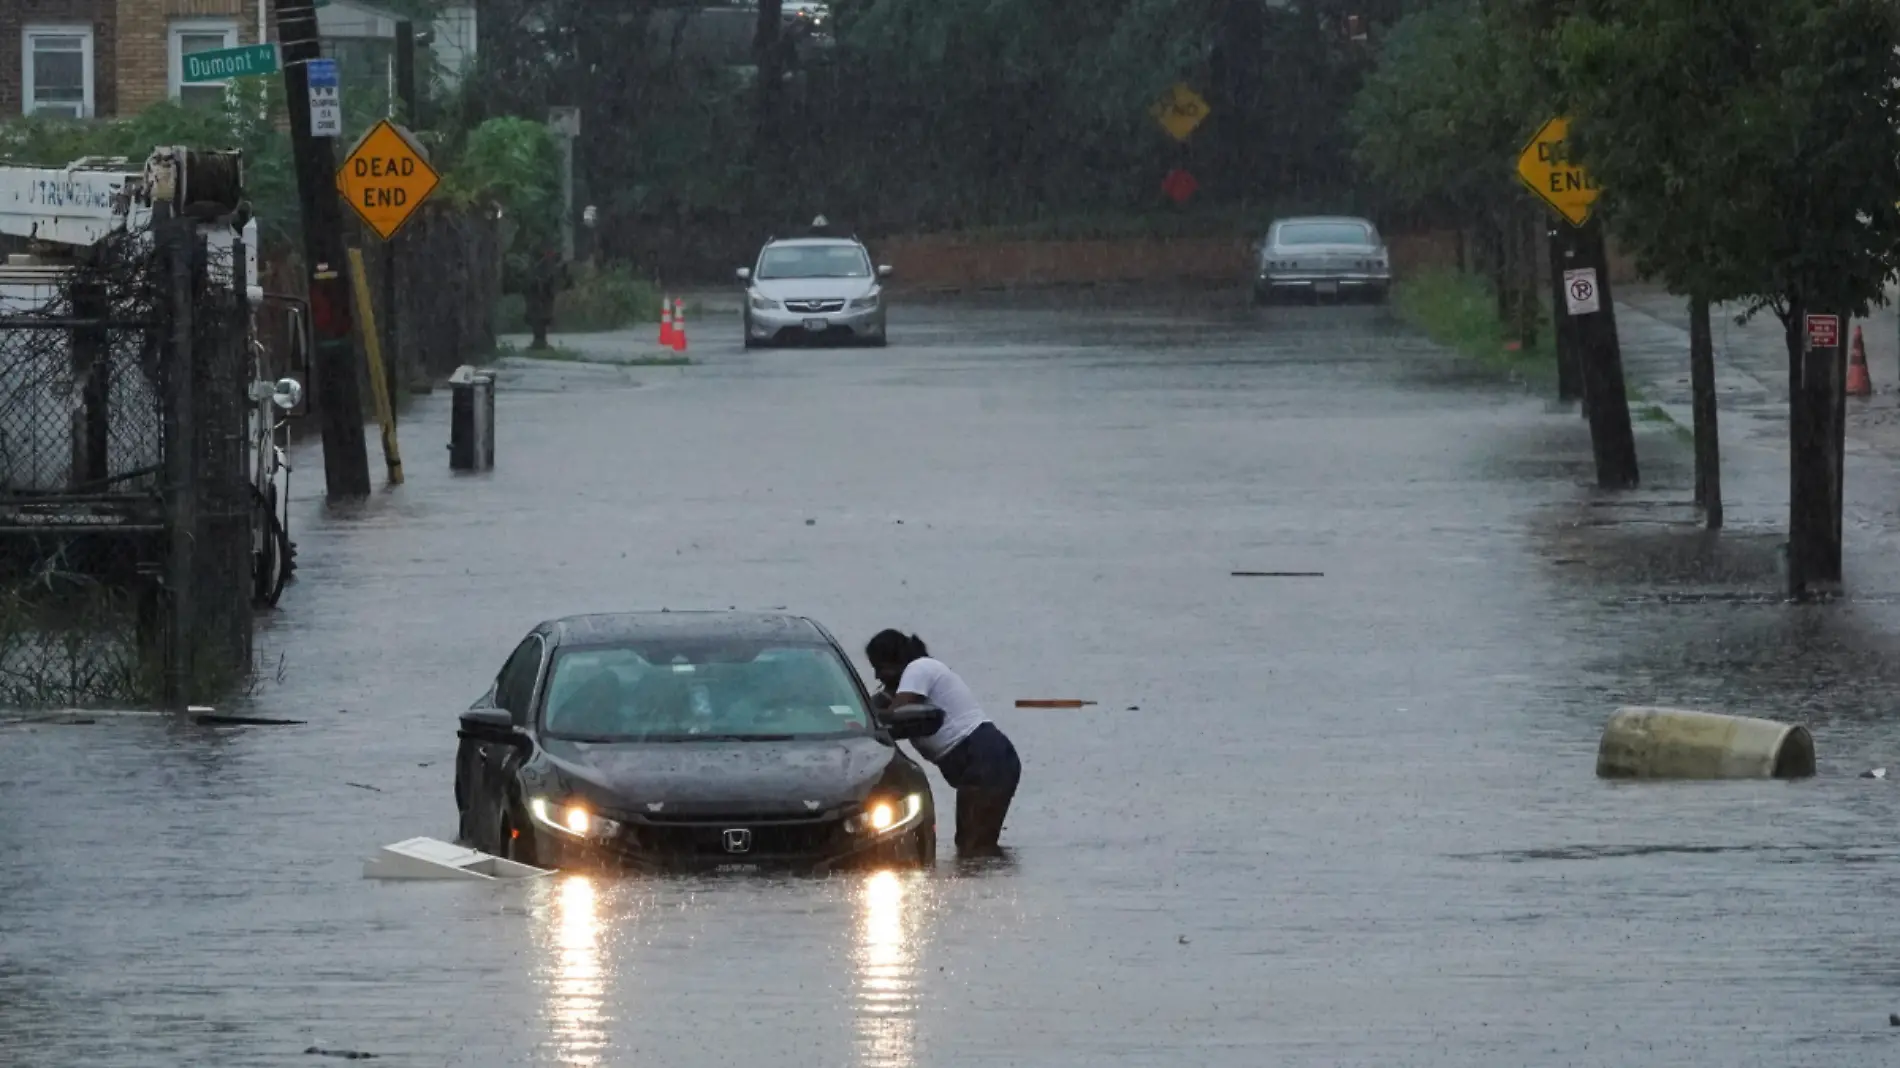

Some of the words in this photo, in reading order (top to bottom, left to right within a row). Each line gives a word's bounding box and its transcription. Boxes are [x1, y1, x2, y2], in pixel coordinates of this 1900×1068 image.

[189, 51, 253, 77] Dumont
[355, 158, 415, 177] DEAD
[364, 187, 406, 207] END
